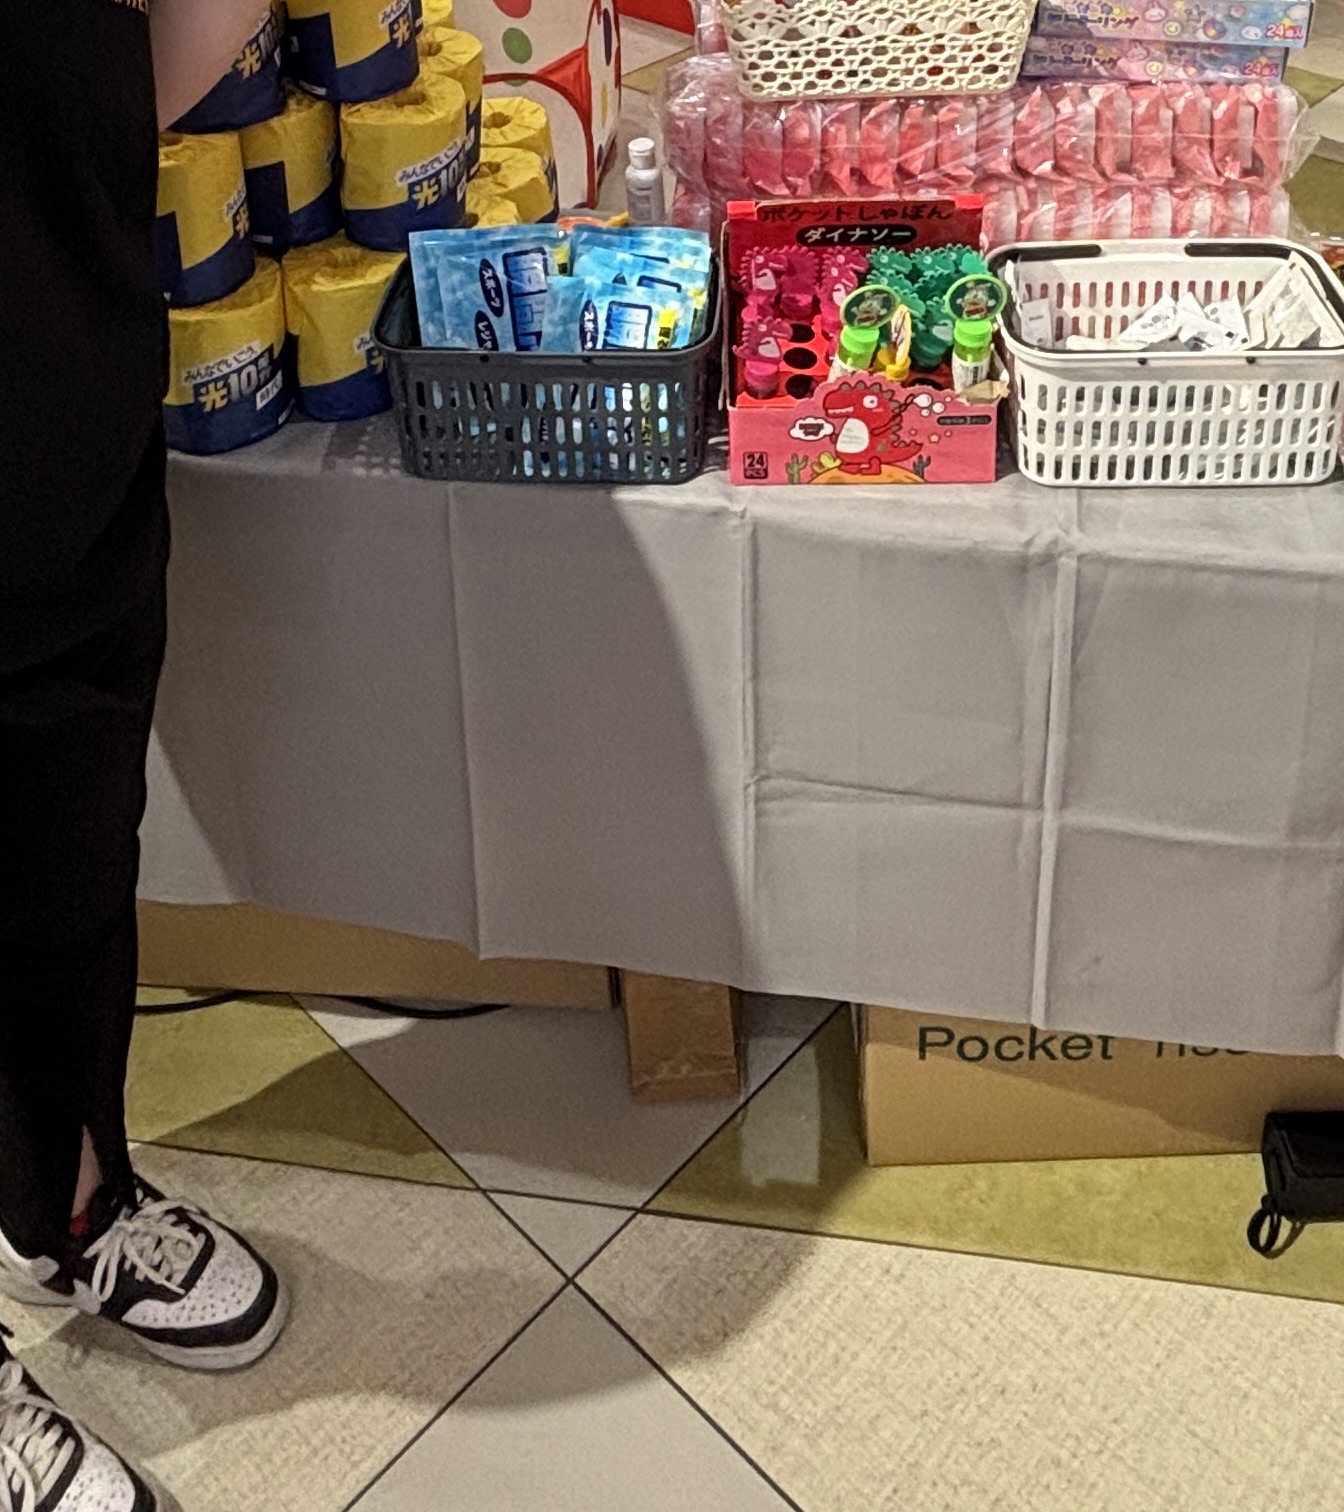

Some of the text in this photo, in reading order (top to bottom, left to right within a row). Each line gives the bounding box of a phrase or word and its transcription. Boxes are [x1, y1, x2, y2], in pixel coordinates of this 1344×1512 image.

[804, 226, 912, 243] ダイナソー
[480, 265, 503, 309] スポーツ
[746, 453, 765, 468] 24
[917, 1025, 1115, 1062] Pocket
